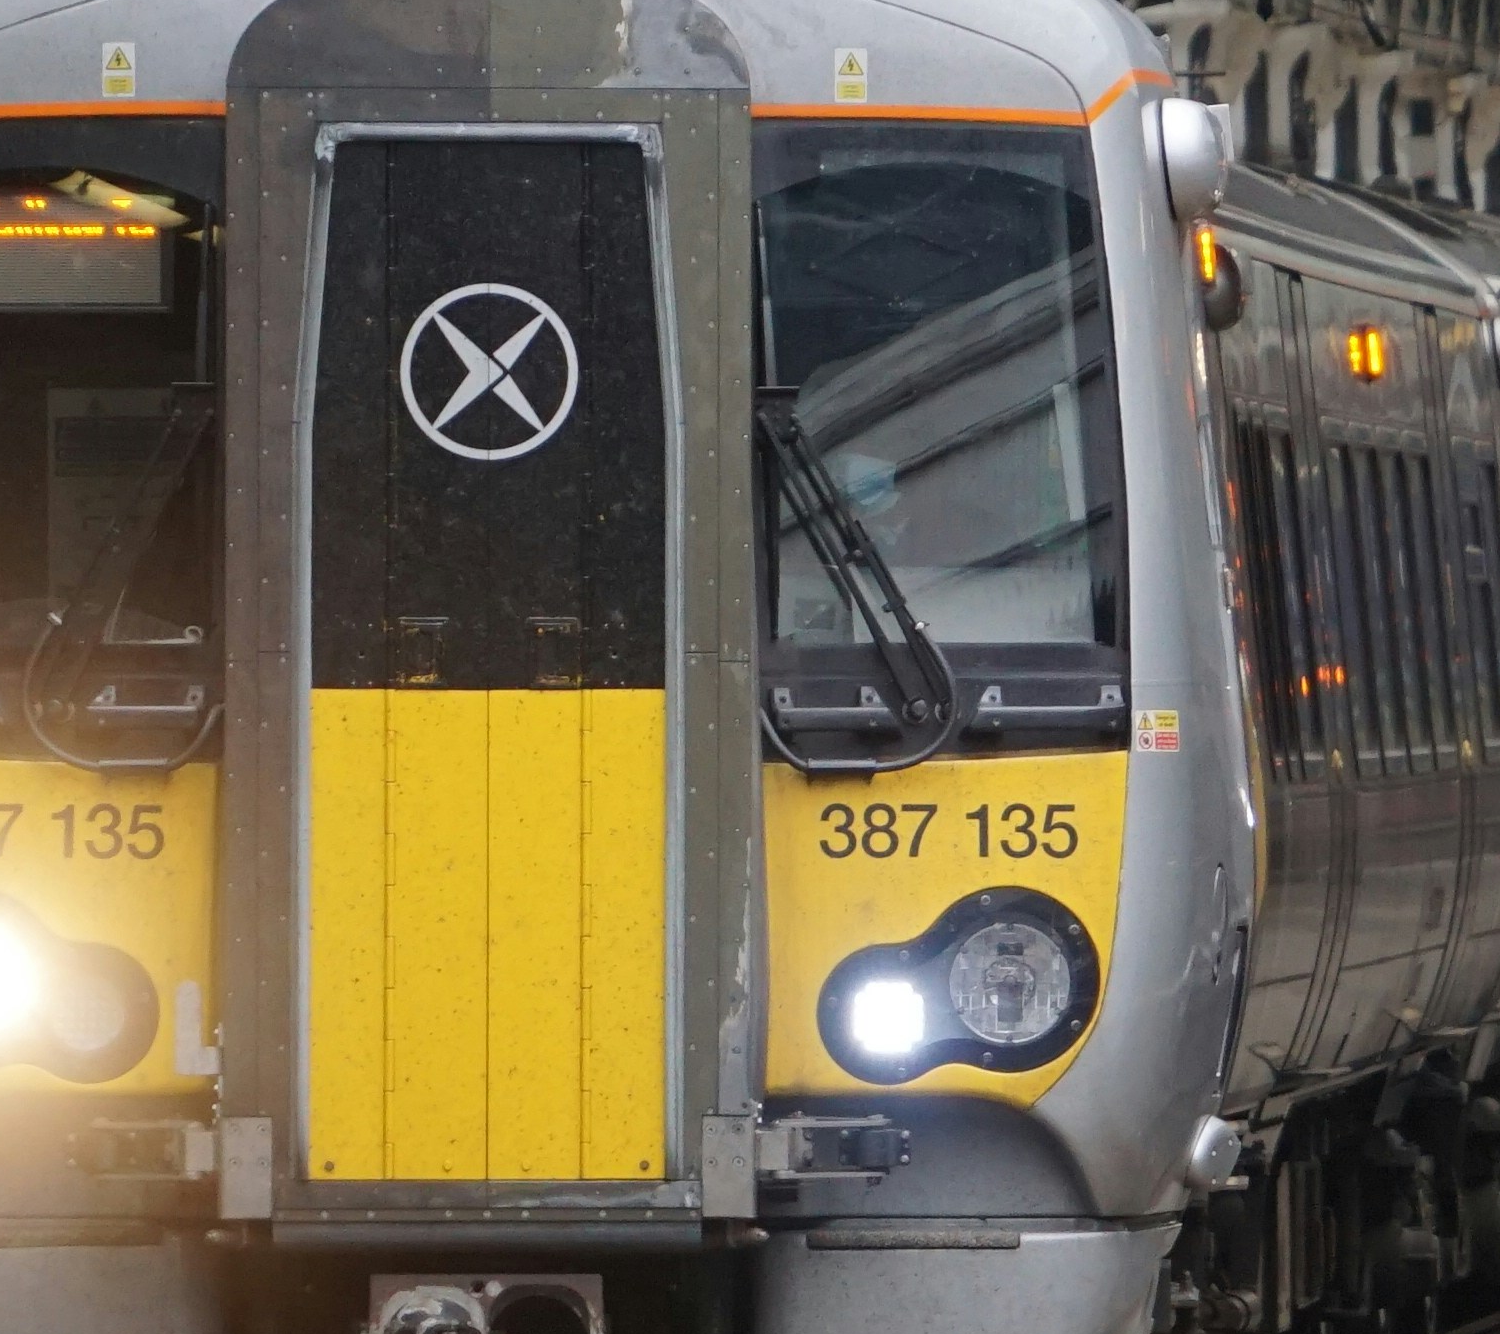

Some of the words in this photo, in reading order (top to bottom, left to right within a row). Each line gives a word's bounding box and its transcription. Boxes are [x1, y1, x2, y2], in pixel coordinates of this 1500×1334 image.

[52, 803, 165, 859] 135
[819, 803, 937, 858] 387
[966, 803, 1079, 858] 135
